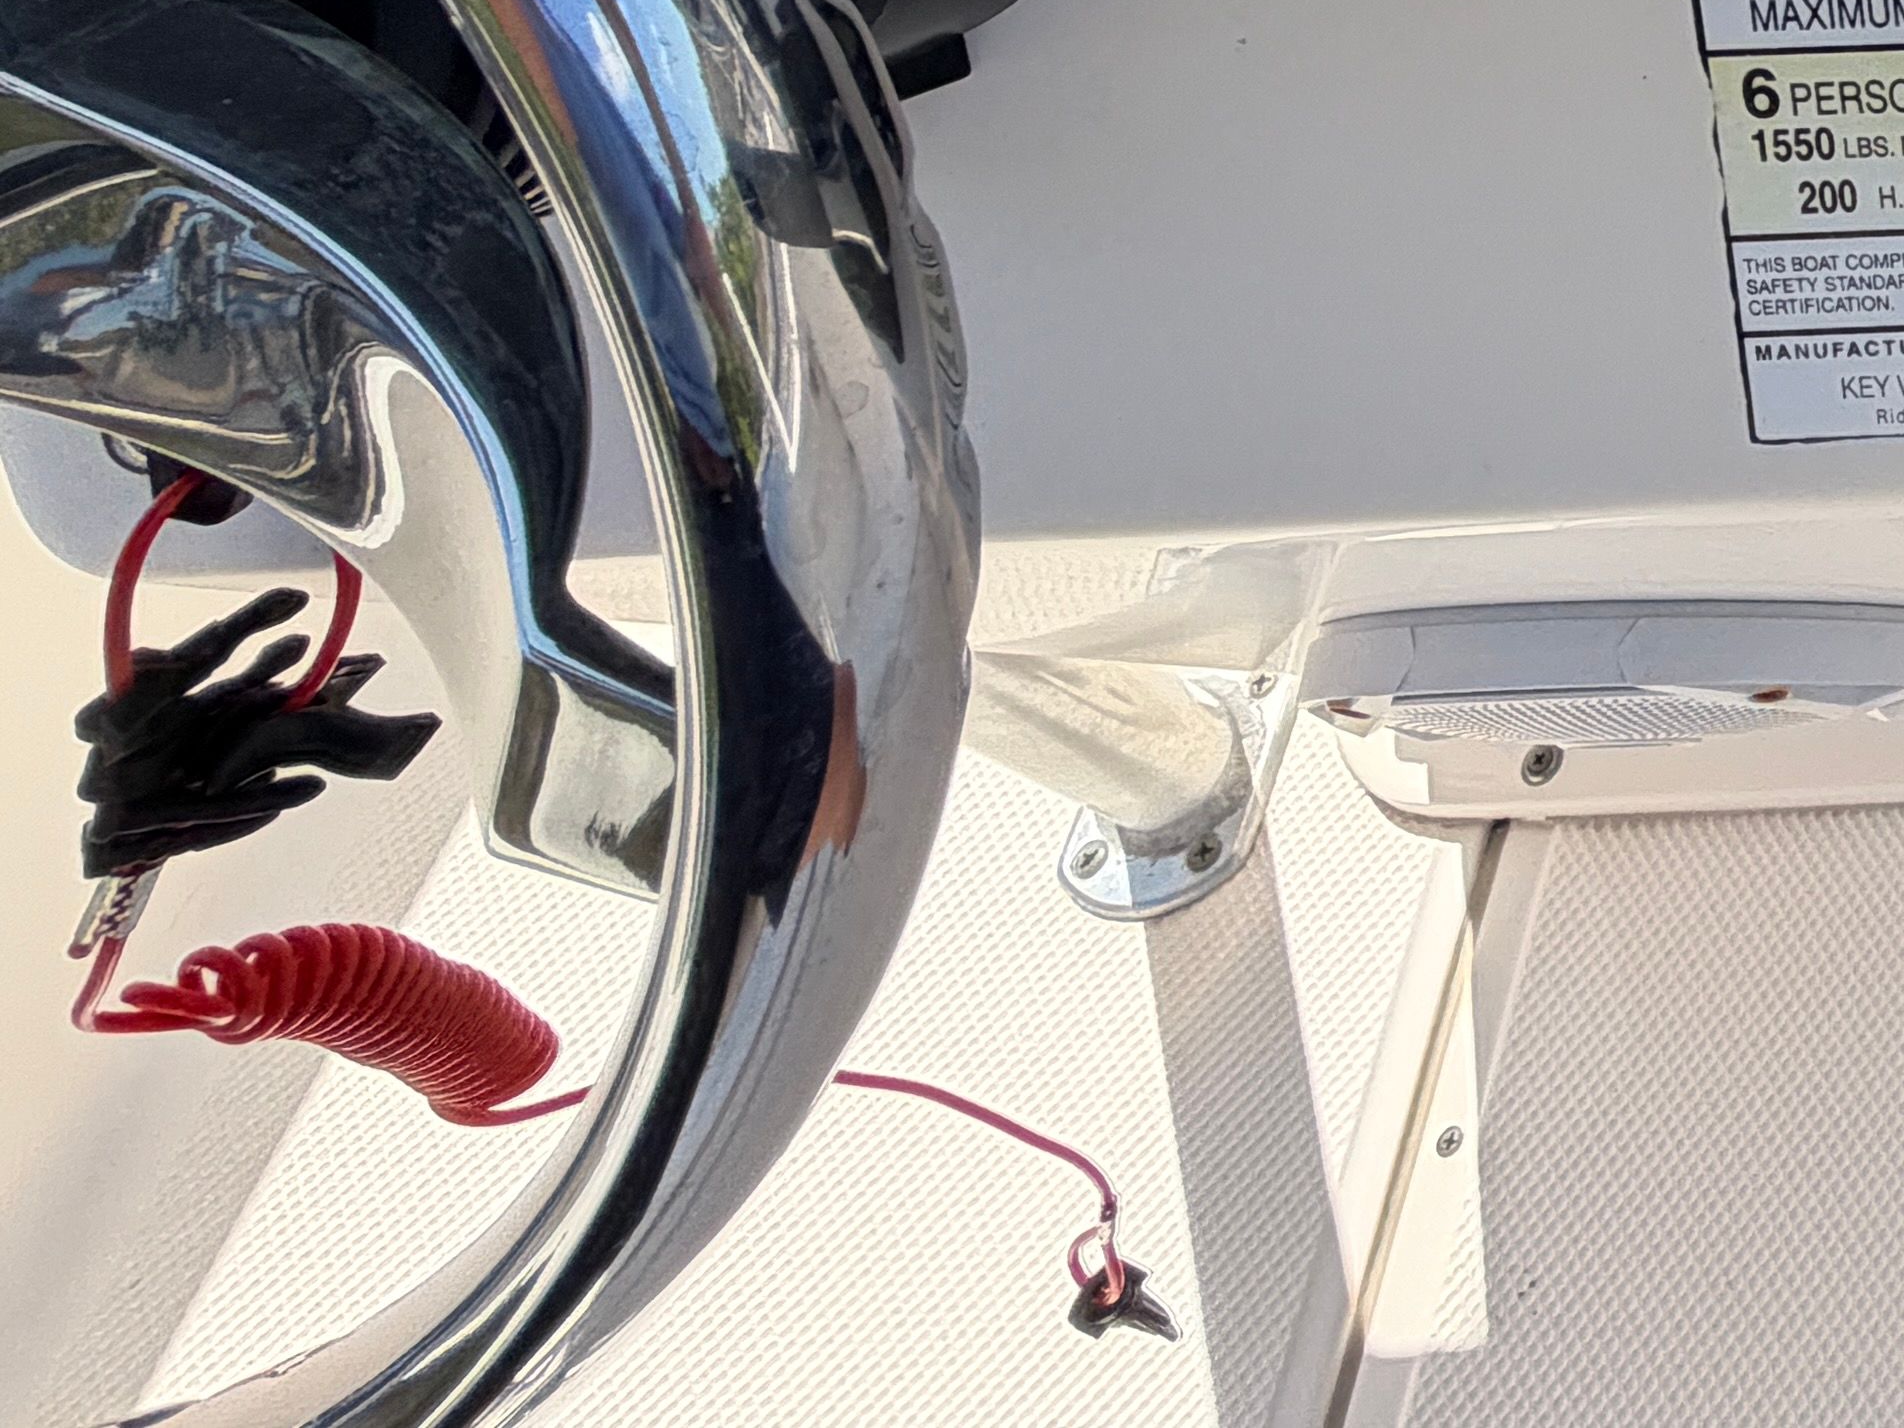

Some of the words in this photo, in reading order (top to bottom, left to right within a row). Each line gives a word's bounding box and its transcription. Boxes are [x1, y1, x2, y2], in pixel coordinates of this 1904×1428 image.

[1742, 68, 1781, 119] 6
[1750, 127, 1837, 163] 1550
[1842, 135, 1897, 159] LBS.
[1799, 180, 1858, 214] 200
[1743, 256, 1786, 275] THIS
[1792, 255, 1841, 273] BOAT
[1745, 275, 1817, 296] SAFETY
[1747, 296, 1896, 318] CERTIFICATION.
[1841, 377, 1894, 400] KEY
